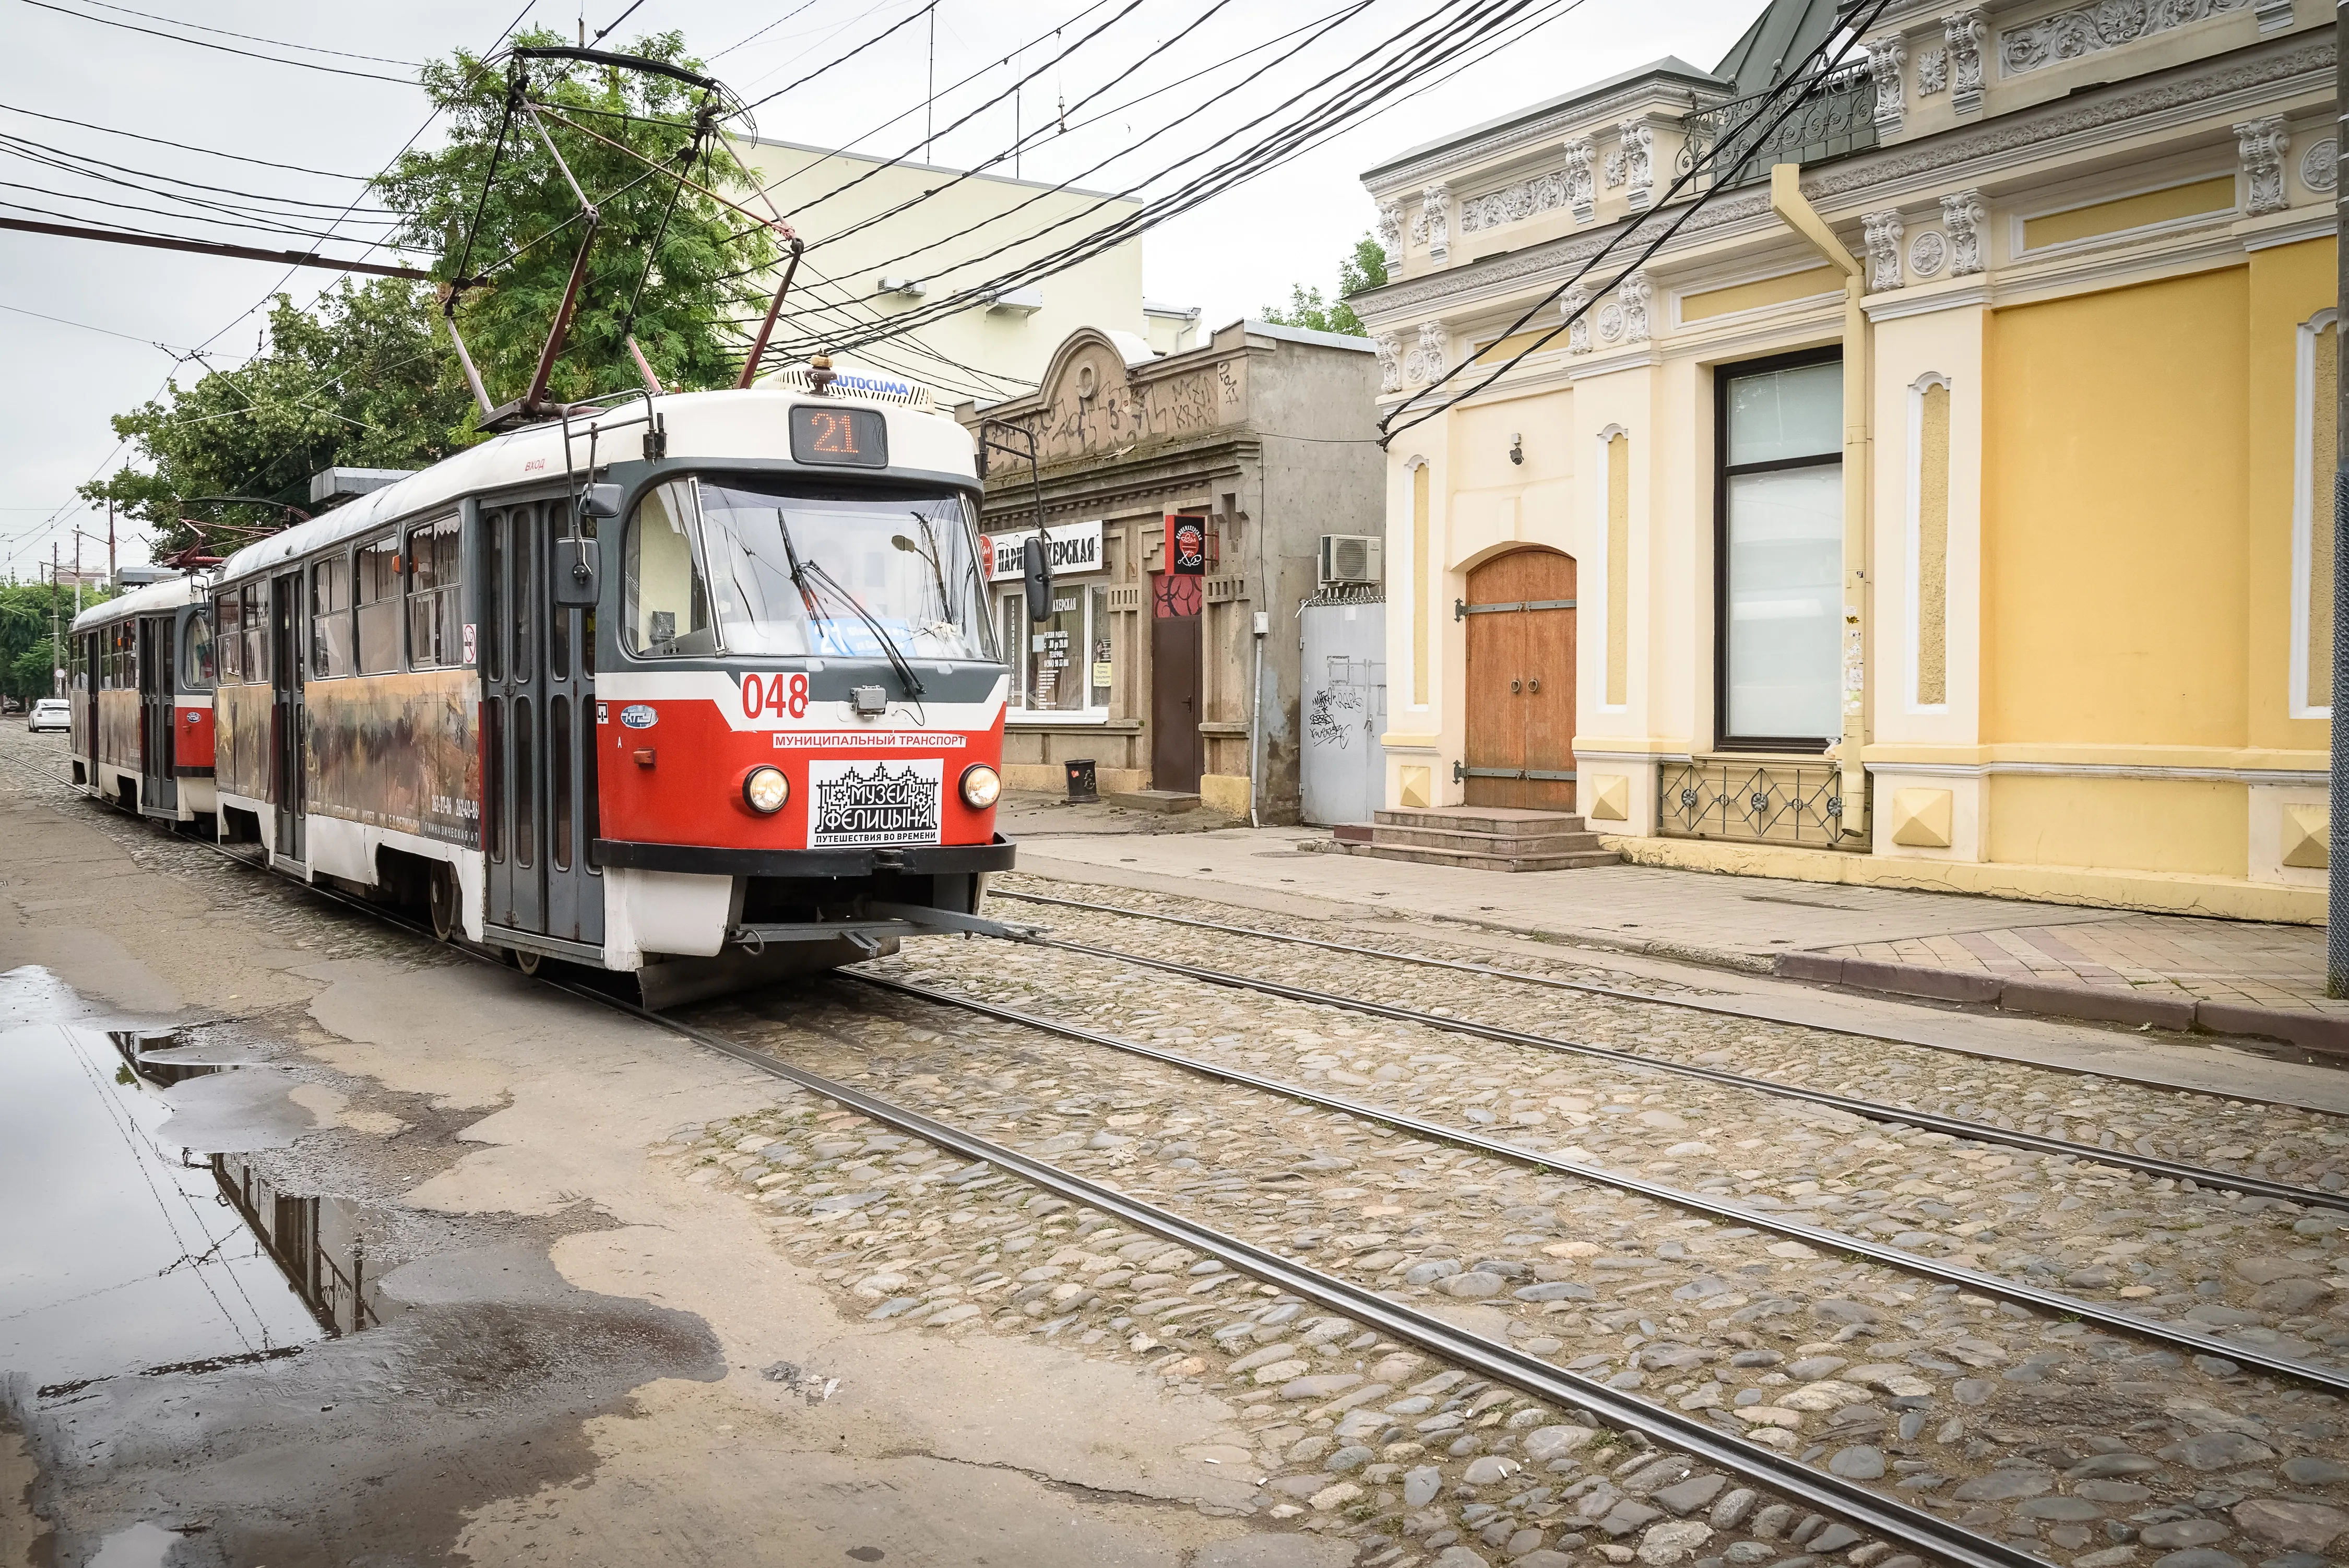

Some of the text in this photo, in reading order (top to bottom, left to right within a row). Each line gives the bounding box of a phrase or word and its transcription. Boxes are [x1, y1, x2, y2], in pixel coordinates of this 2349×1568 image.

[829, 375, 909, 396] AUTOCLIMA
[811, 413, 859, 453] 21
[525, 458, 545, 471] ВХОД
[1052, 597, 1076, 612] АХЕРСКАЯ
[814, 622, 846, 653] 21
[743, 674, 808, 719] 048
[776, 735, 965, 746] МУНИЦИПАЛЬНЫЙ ТРАНСПОРТ
[851, 781, 908, 804] МУЗЕЙ
[432, 794, 478, 819] 262-27-06 262-40-86
[825, 809, 931, 830] ФЕЛИЦЫНА
[816, 834, 881, 842] ПУТЕШЕСТВИЯ
[897, 832, 935, 840] ВРЕМЕНИ
